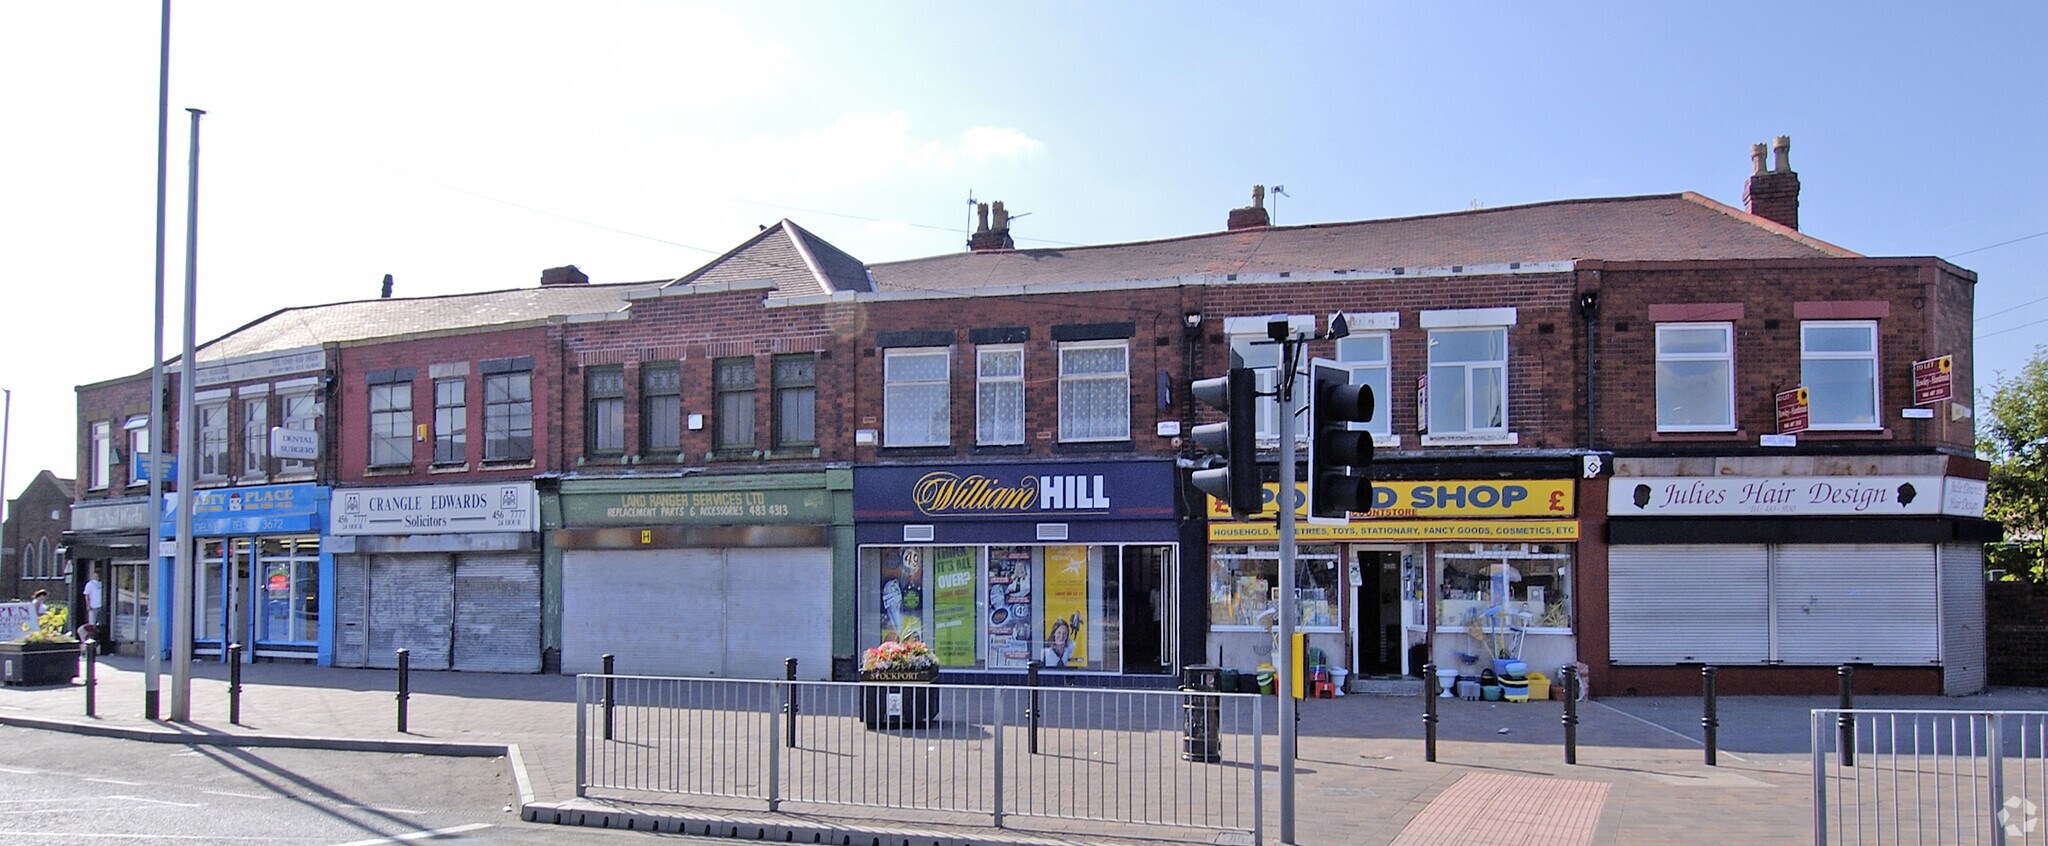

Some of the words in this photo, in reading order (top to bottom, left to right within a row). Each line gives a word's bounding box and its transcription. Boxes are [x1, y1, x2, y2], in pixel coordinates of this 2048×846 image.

[282, 435, 315, 444] DENTAL
[244, 489, 294, 503] PLACE
[621, 494, 646, 508] LAND
[649, 493, 689, 507] RANGER
[693, 491, 743, 506] SERVICES
[745, 491, 765, 506] LTD
[912, 471, 1040, 514] William
[1040, 475, 1110, 509] HILL
[1411, 485, 1528, 510] SHOP
[1659, 480, 1727, 508] Julies
[1738, 479, 1796, 504] Hair
[1808, 481, 1888, 512] Design
[369, 496, 422, 512] CRANGLE
[431, 493, 488, 510] EDWARDS
[607, 507, 657, 518] REPLACEMENT
[660, 506, 685, 517] PARTS
[700, 505, 744, 517] ACCESSORIES
[749, 505, 767, 516] 483
[768, 504, 789, 516] 4313
[262, 518, 283, 530] 3672
[405, 514, 448, 528] Solicitors
[1213, 527, 1272, 537] HOUSEHOLD,
[1332, 527, 1359, 536] TOYS,
[1360, 526, 1420, 535] STATIONARY,
[1423, 526, 1455, 535] FANCY
[1457, 526, 1493, 536] GOODS,
[1496, 526, 1555, 536] COSMETICS,
[1556, 526, 1575, 535] ETC
[937, 571, 971, 590] OVER?
[870, 672, 920, 680] STOCKPORT
